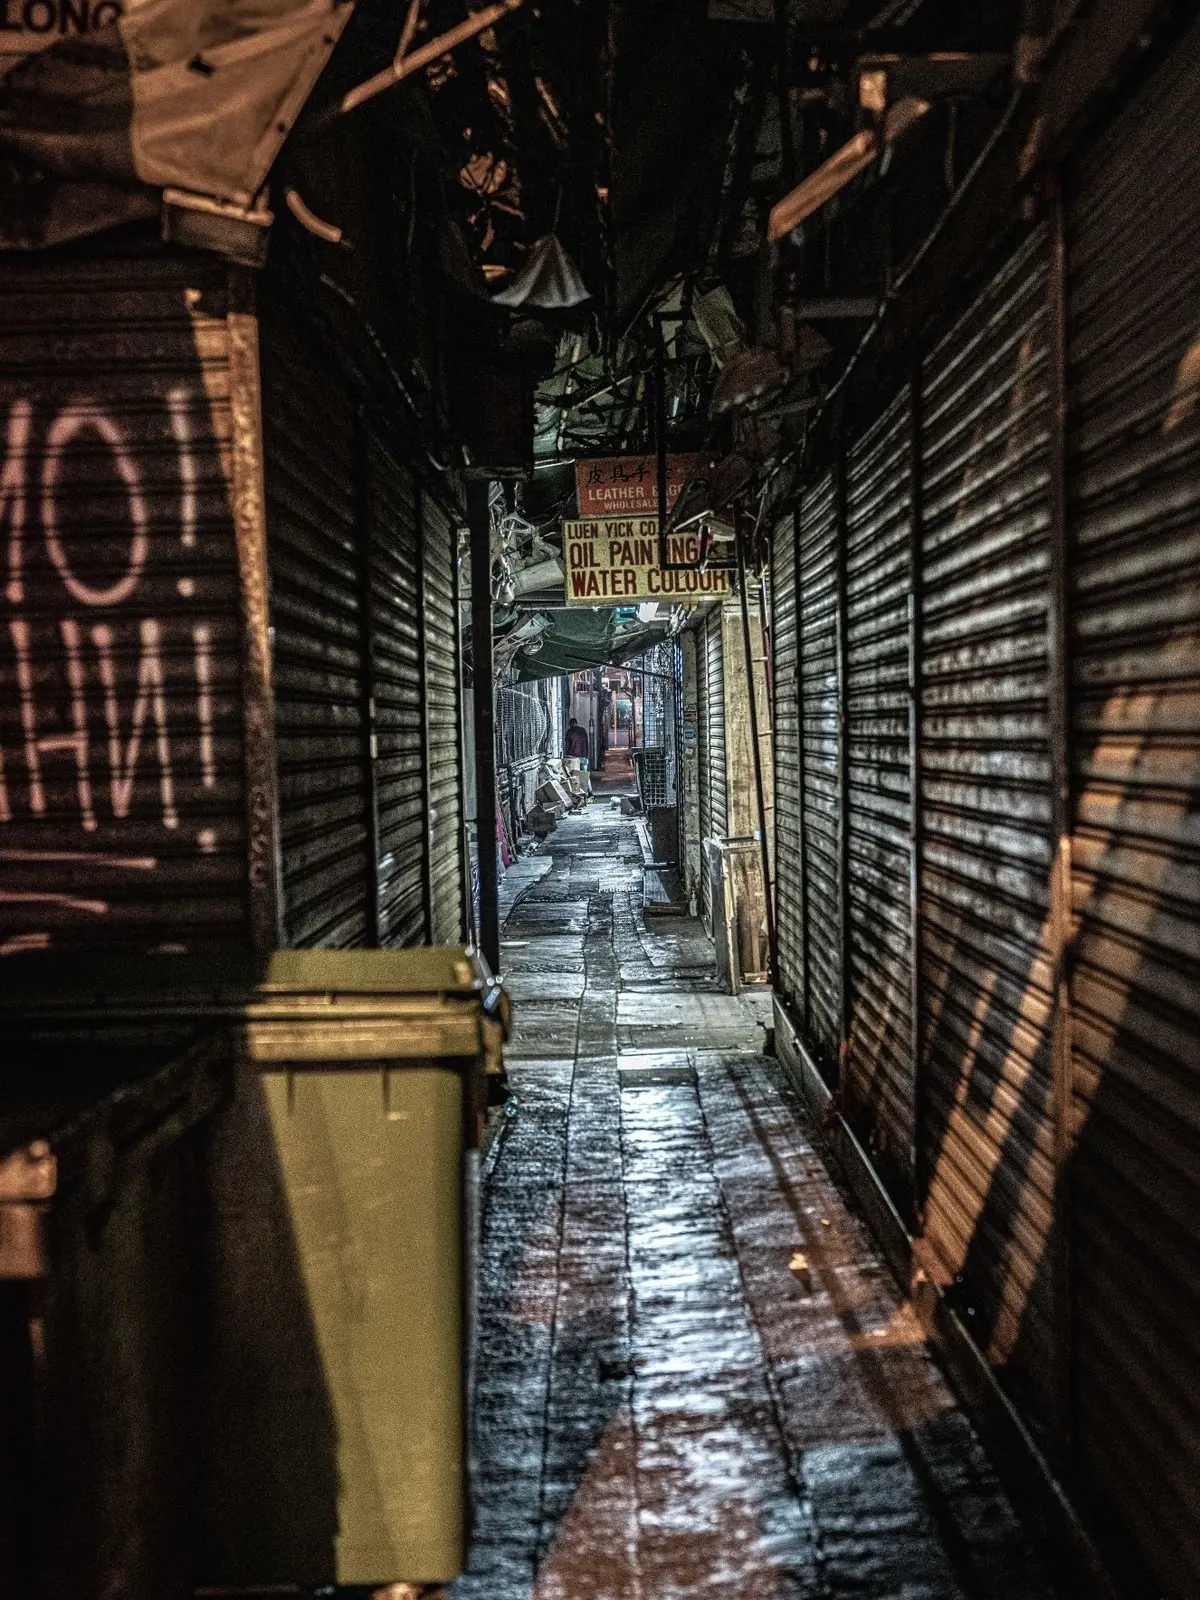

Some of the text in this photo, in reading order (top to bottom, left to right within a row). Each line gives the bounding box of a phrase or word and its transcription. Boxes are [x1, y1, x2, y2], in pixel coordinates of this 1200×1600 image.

[588, 487, 645, 501] LEATHER
[604, 499, 660, 511] WHOLESALE
[567, 522, 599, 539] LUEN
[604, 521, 634, 538] YICK
[569, 542, 601, 569] OIL
[571, 567, 727, 597] WATER COLOUR
